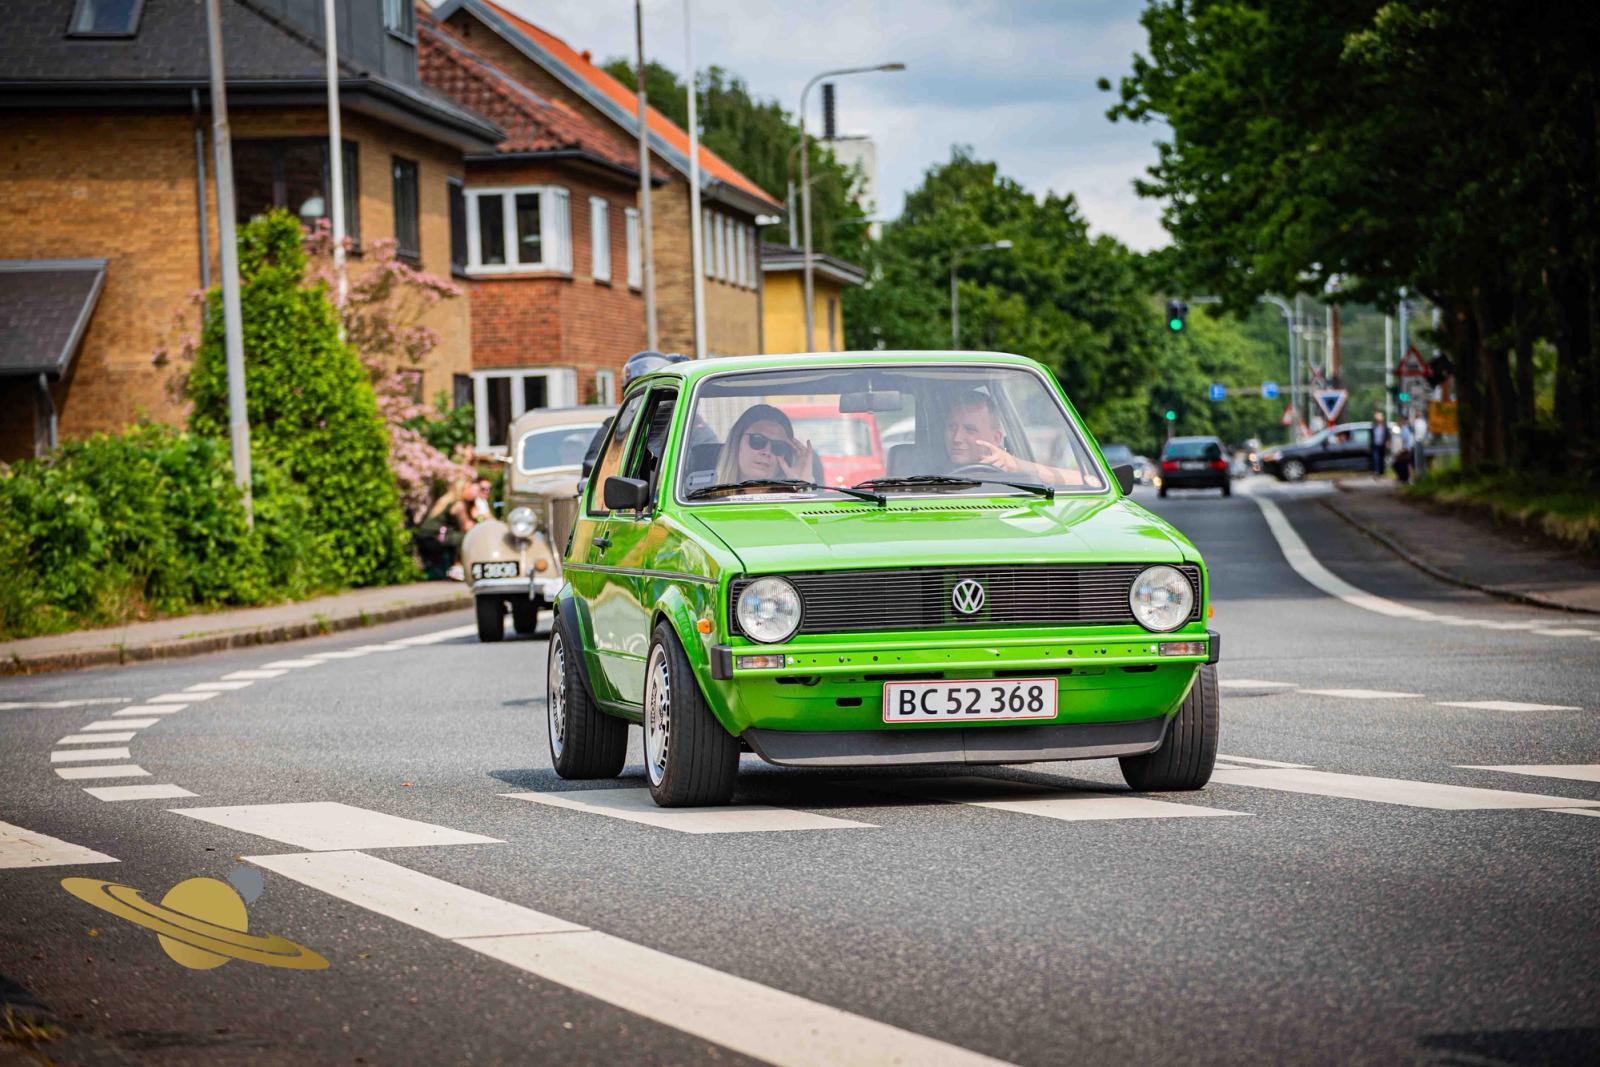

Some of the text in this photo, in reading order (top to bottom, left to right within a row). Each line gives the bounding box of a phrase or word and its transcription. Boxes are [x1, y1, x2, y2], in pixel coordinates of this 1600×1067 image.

[899, 688, 938, 716] BC
[946, 687, 981, 715] 52
[990, 685, 1044, 713] 368
